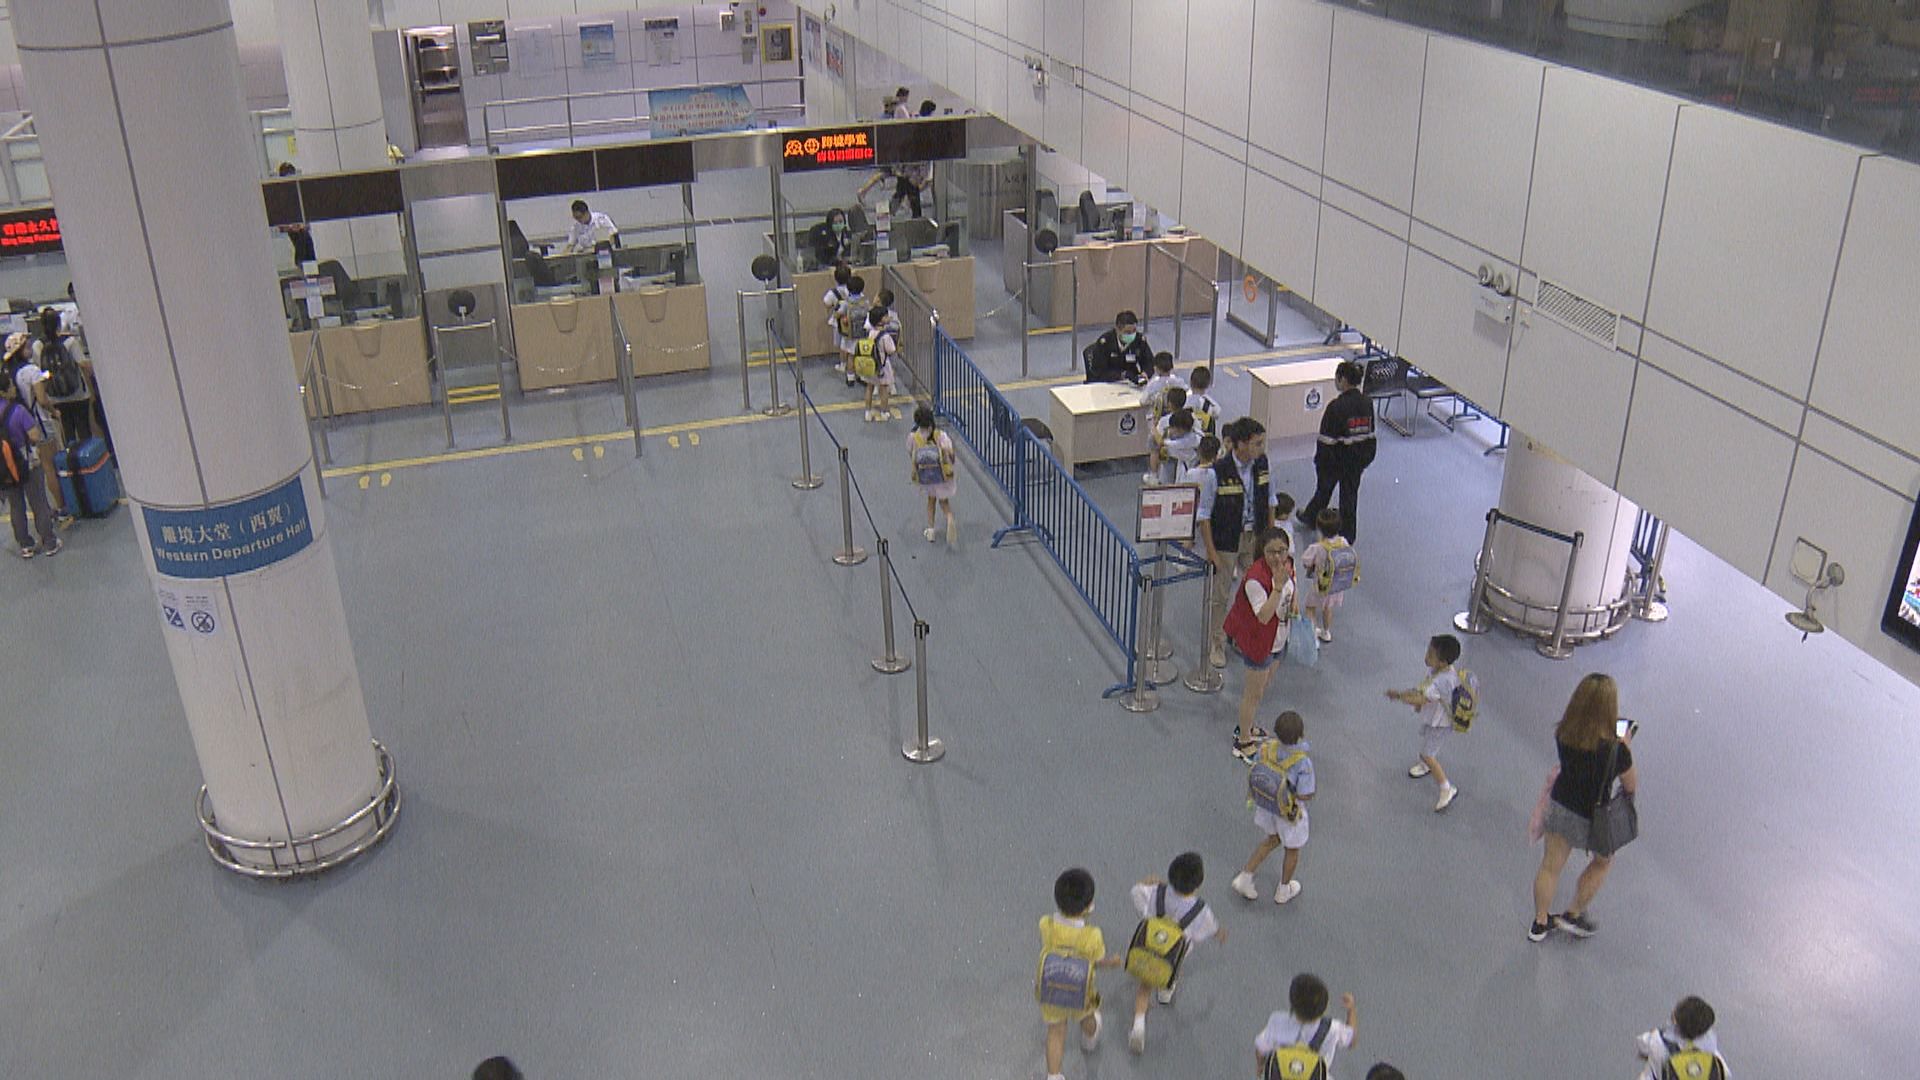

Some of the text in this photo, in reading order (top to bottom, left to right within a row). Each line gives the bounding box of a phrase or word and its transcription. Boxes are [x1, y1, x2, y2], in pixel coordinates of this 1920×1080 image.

[156, 517, 307, 562] Western Departure Hall
